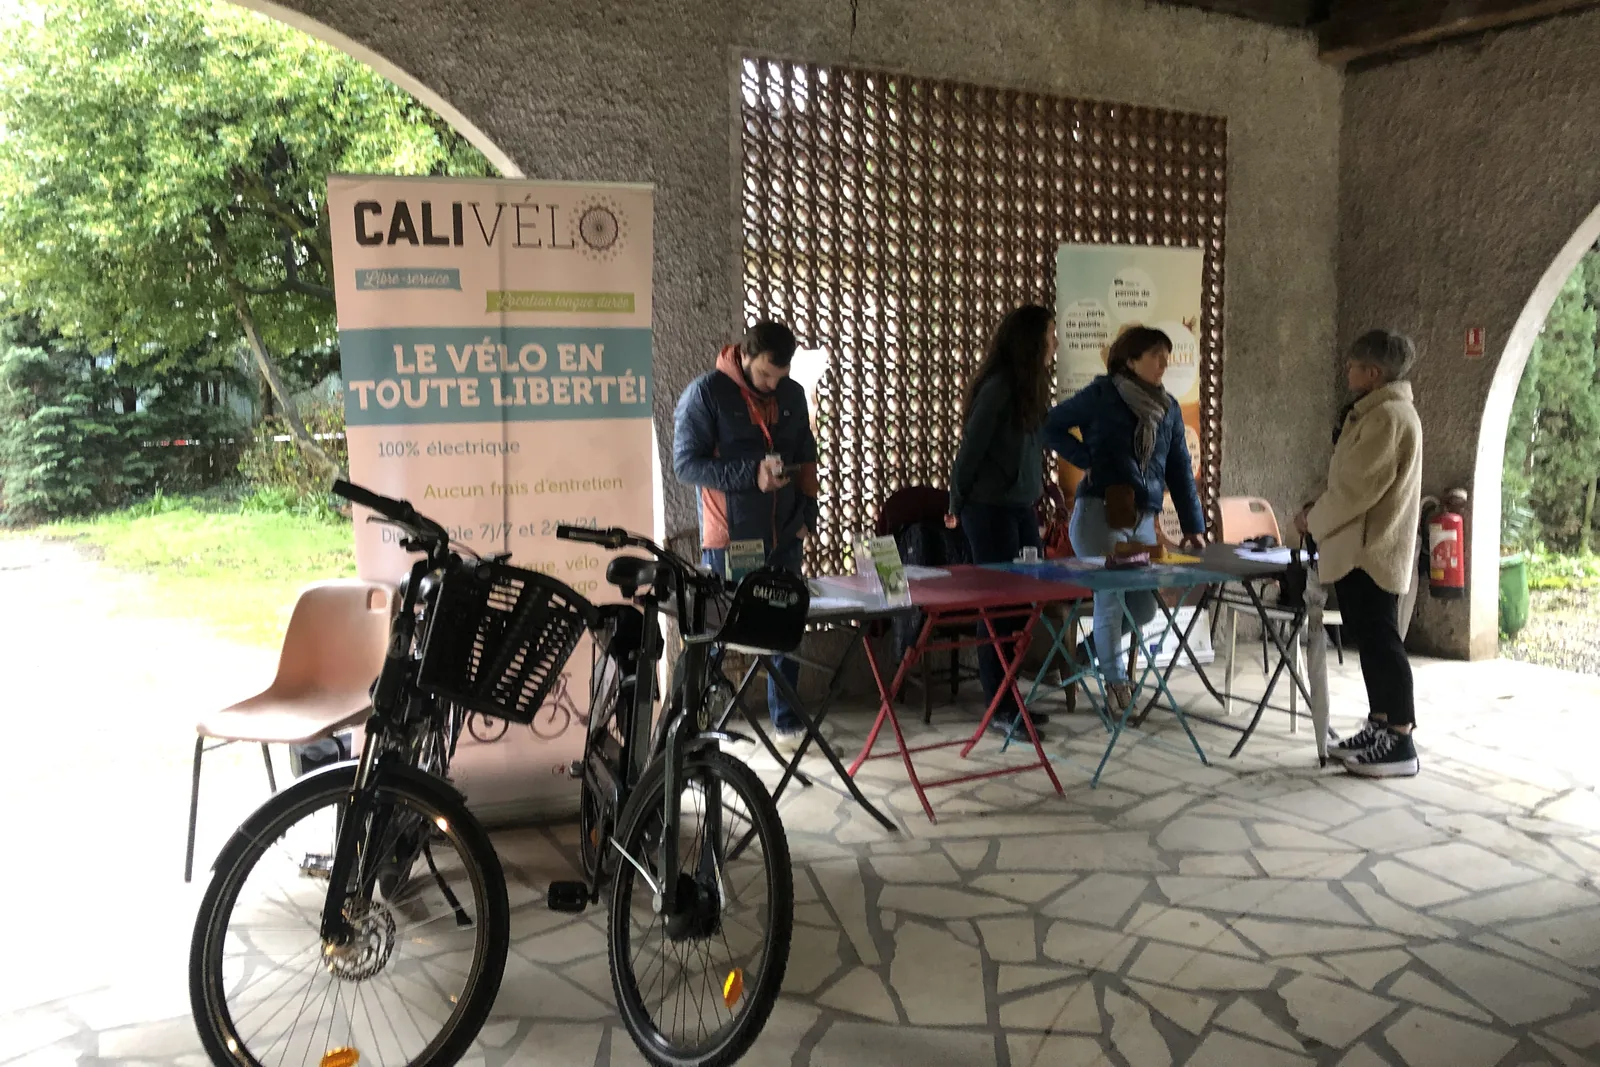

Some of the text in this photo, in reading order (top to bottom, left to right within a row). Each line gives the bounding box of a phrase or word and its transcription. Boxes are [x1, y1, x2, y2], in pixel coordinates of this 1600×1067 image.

[394, 336, 605, 375] LE VÉLO EN
[349, 368, 647, 410] TOUTE LIBERTÉ!
[378, 439, 521, 458] 100% électrique
[423, 475, 624, 500] Aucun frais d'entretien
[479, 522, 513, 543] 7j/7
[518, 522, 535, 538] et
[565, 553, 600, 571] vélo
